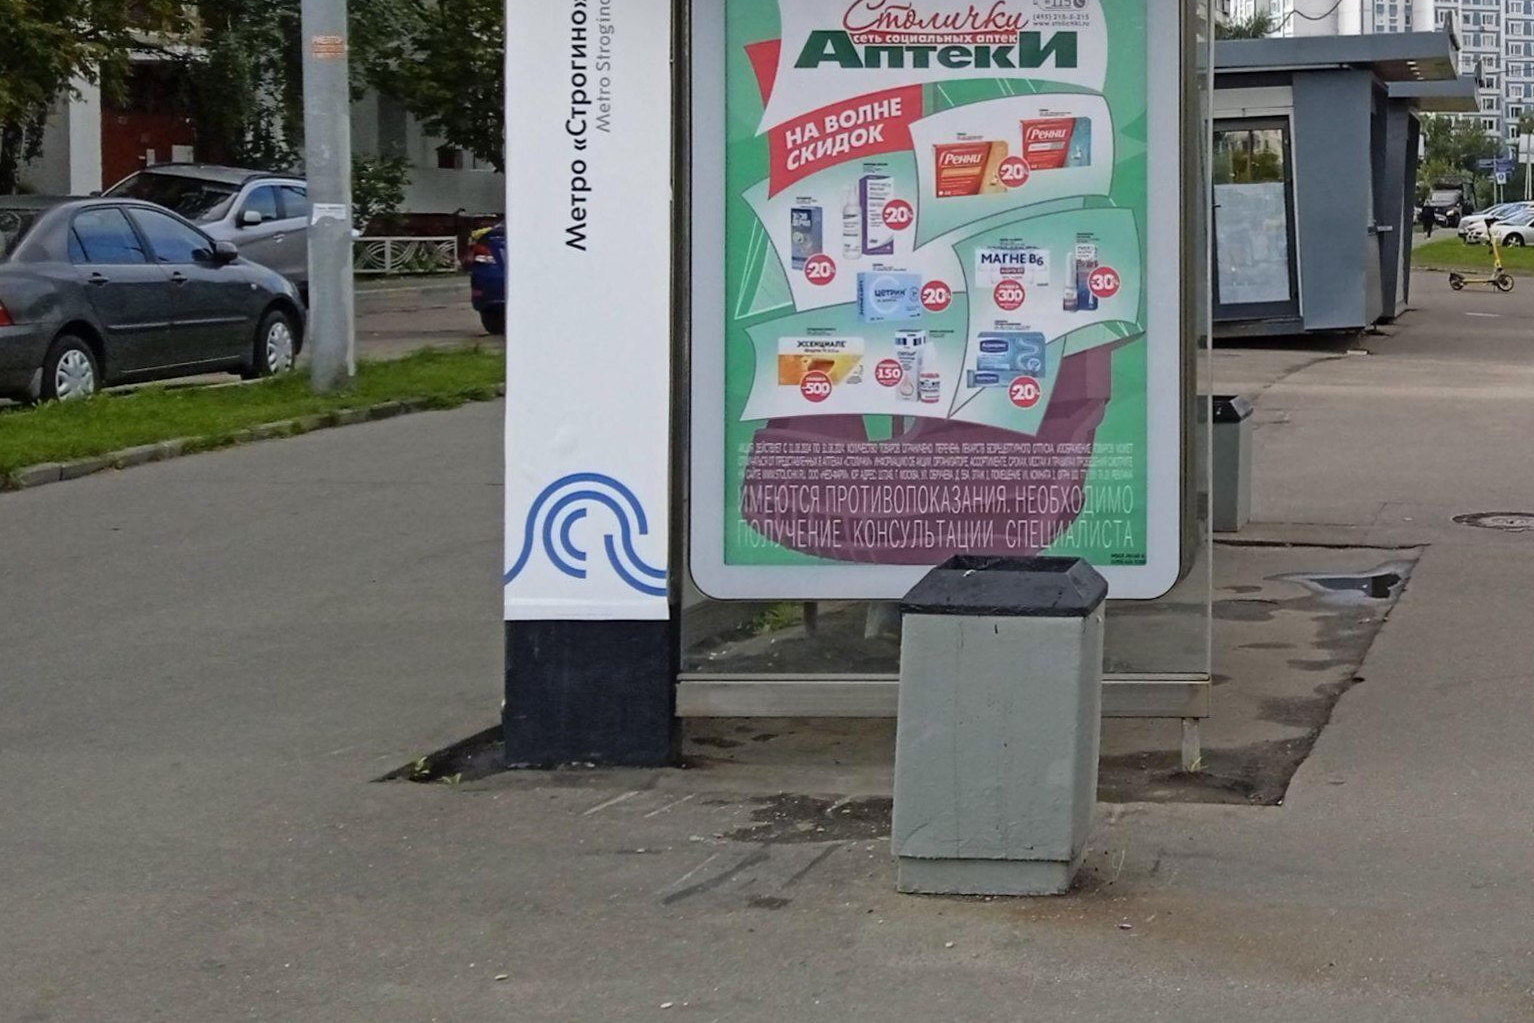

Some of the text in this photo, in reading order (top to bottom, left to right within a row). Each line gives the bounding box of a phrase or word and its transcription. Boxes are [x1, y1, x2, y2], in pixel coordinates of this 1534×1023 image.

[854, 34, 1017, 44] сеть социальных аптек
[596, 76, 611, 133] Metro
[786, 97, 902, 149] НА ВОЛНЕ
[786, 124, 884, 170] СКИДОК
[565, 159, 592, 251] Метро
[981, 253, 1026, 264] МАГНЕ
[738, 485, 1134, 518] ИМЕЮТСЯ ПРОТИВОПОКАЗАНИЯ. НЕОБХОДИМО
[738, 519, 1135, 552] ПОЛУЧЕНИЕ КОНСУЛЬТАЦИИ СПЕЦИАЛИСТА
